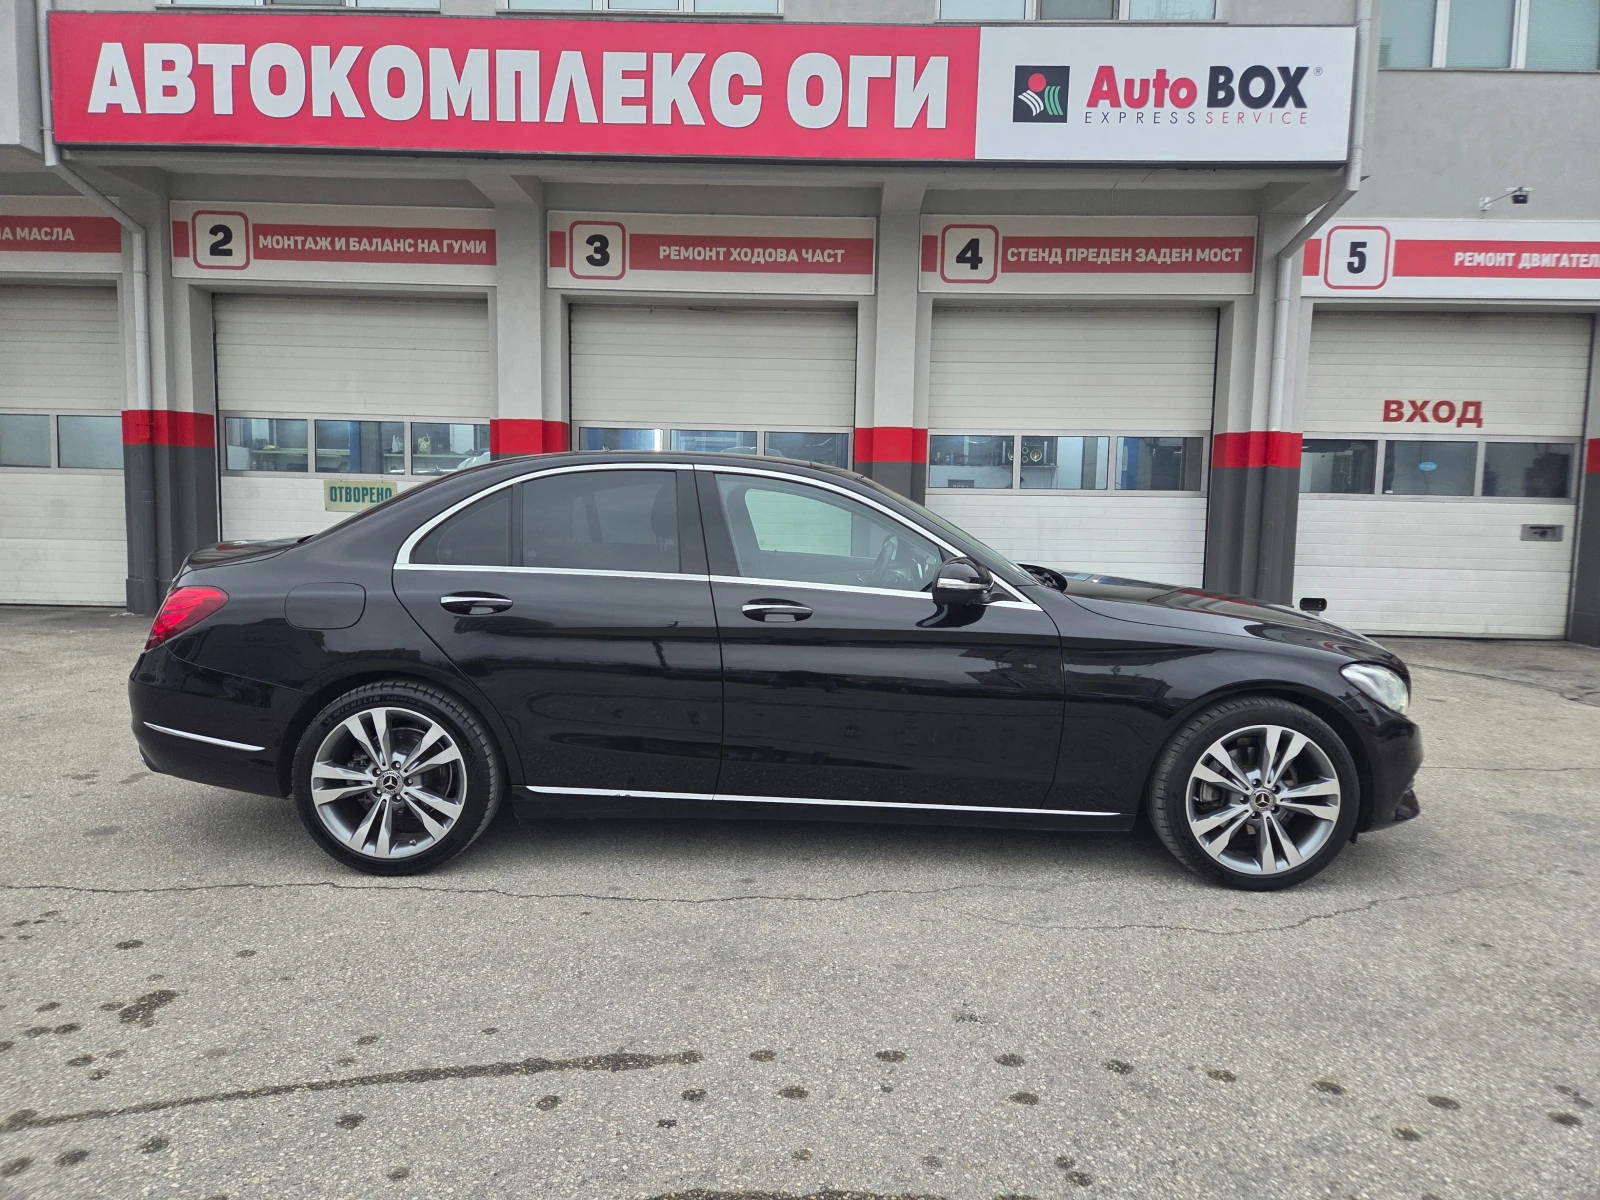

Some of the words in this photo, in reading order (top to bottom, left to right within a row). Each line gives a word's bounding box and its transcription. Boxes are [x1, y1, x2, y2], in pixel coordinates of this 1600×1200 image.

[88, 43, 763, 128] АВТОКОМПЛЕКС
[786, 52, 949, 131] ОГИ
[1086, 65, 1198, 109] Auto
[1206, 65, 1309, 109] BOX
[0, 227, 14, 240] А
[16, 227, 75, 241] МАСЛА
[209, 224, 233, 257] 2
[258, 235, 332, 250] МОНТАЖ
[335, 237, 347, 250] И
[350, 238, 415, 253] БАЛАНС
[418, 239, 440, 253] НА
[443, 240, 487, 254] ГУМИ
[585, 234, 611, 267] 3
[659, 246, 727, 261] РЕМОНТ
[730, 247, 798, 264] ХОДОВА
[802, 249, 845, 263] ЧАСТ
[955, 238, 983, 270] 4
[1007, 248, 1062, 264] СТЕНД
[1066, 248, 1132, 264] ПРЕДЕН
[1135, 248, 1192, 264] ЗАДЕН
[1196, 248, 1242, 262] МОСТ
[1347, 241, 1368, 274] 5
[1454, 252, 1516, 267] РЕМОНТ
[1382, 400, 1483, 428] ВХОД
[329, 486, 393, 503] ОТВОРЕНО
[333, 696, 381, 718] MICHELIN
